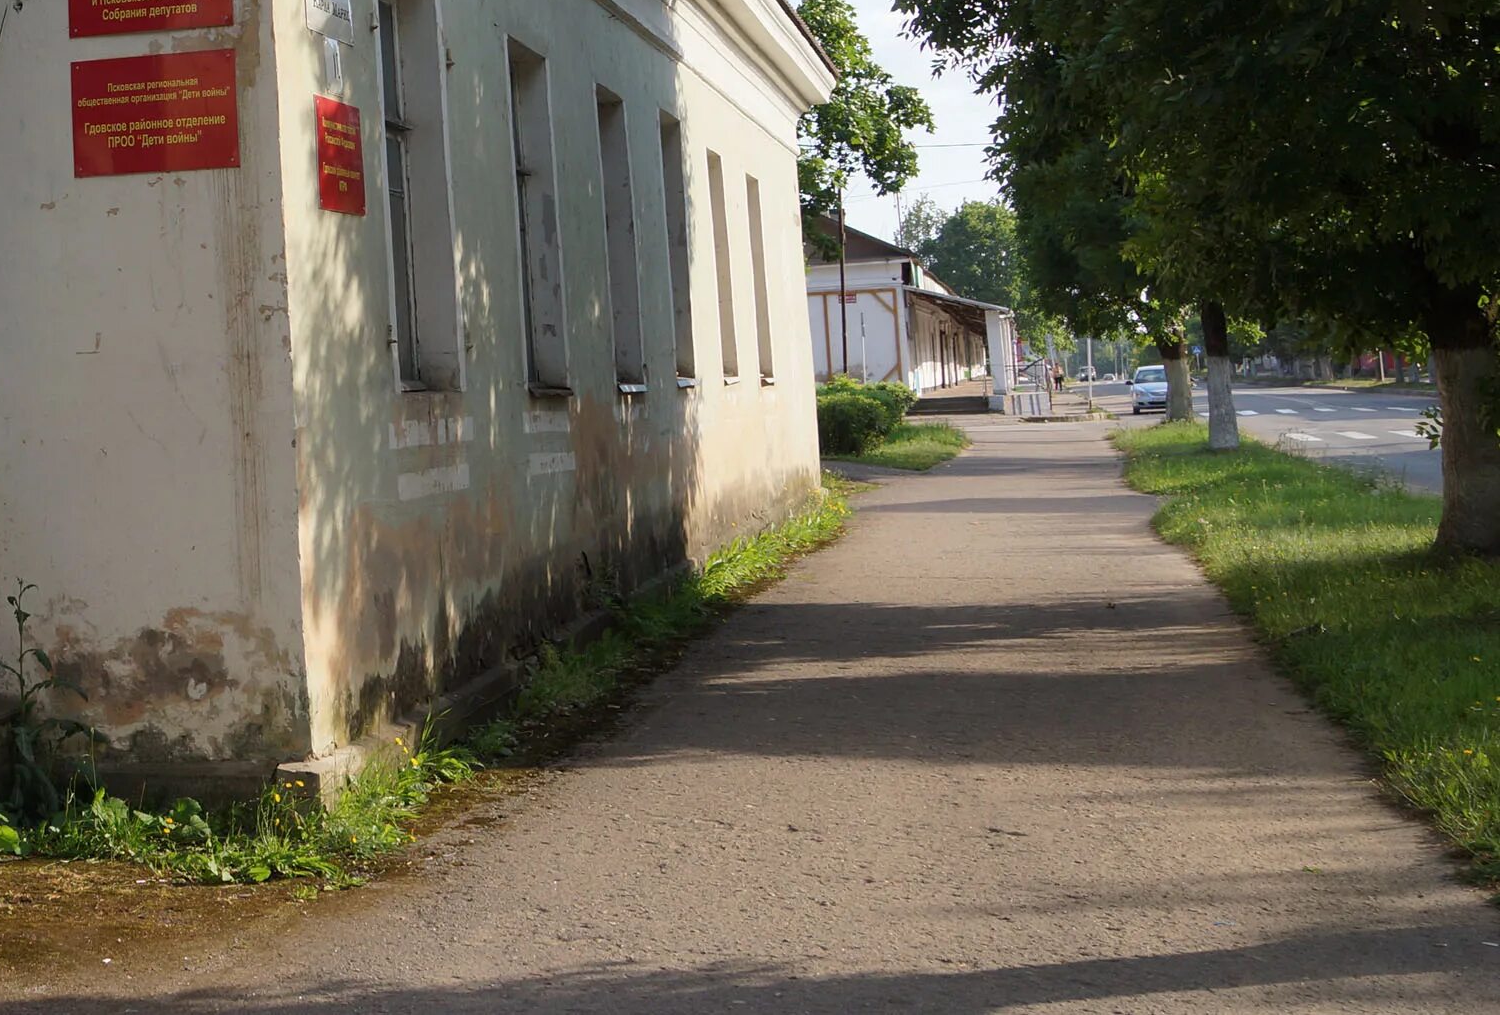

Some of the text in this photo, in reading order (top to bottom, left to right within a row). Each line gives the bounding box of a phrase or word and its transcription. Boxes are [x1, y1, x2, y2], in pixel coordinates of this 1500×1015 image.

[102, 3, 197, 21] Собрания депутатов
[107, 77, 198, 92] Псковская региональная
[77, 94, 129, 107] общественная
[131, 92, 177, 104] организация
[84, 115, 226, 135] Гдовское районное отделение
[108, 136, 135, 148] ПРОО
